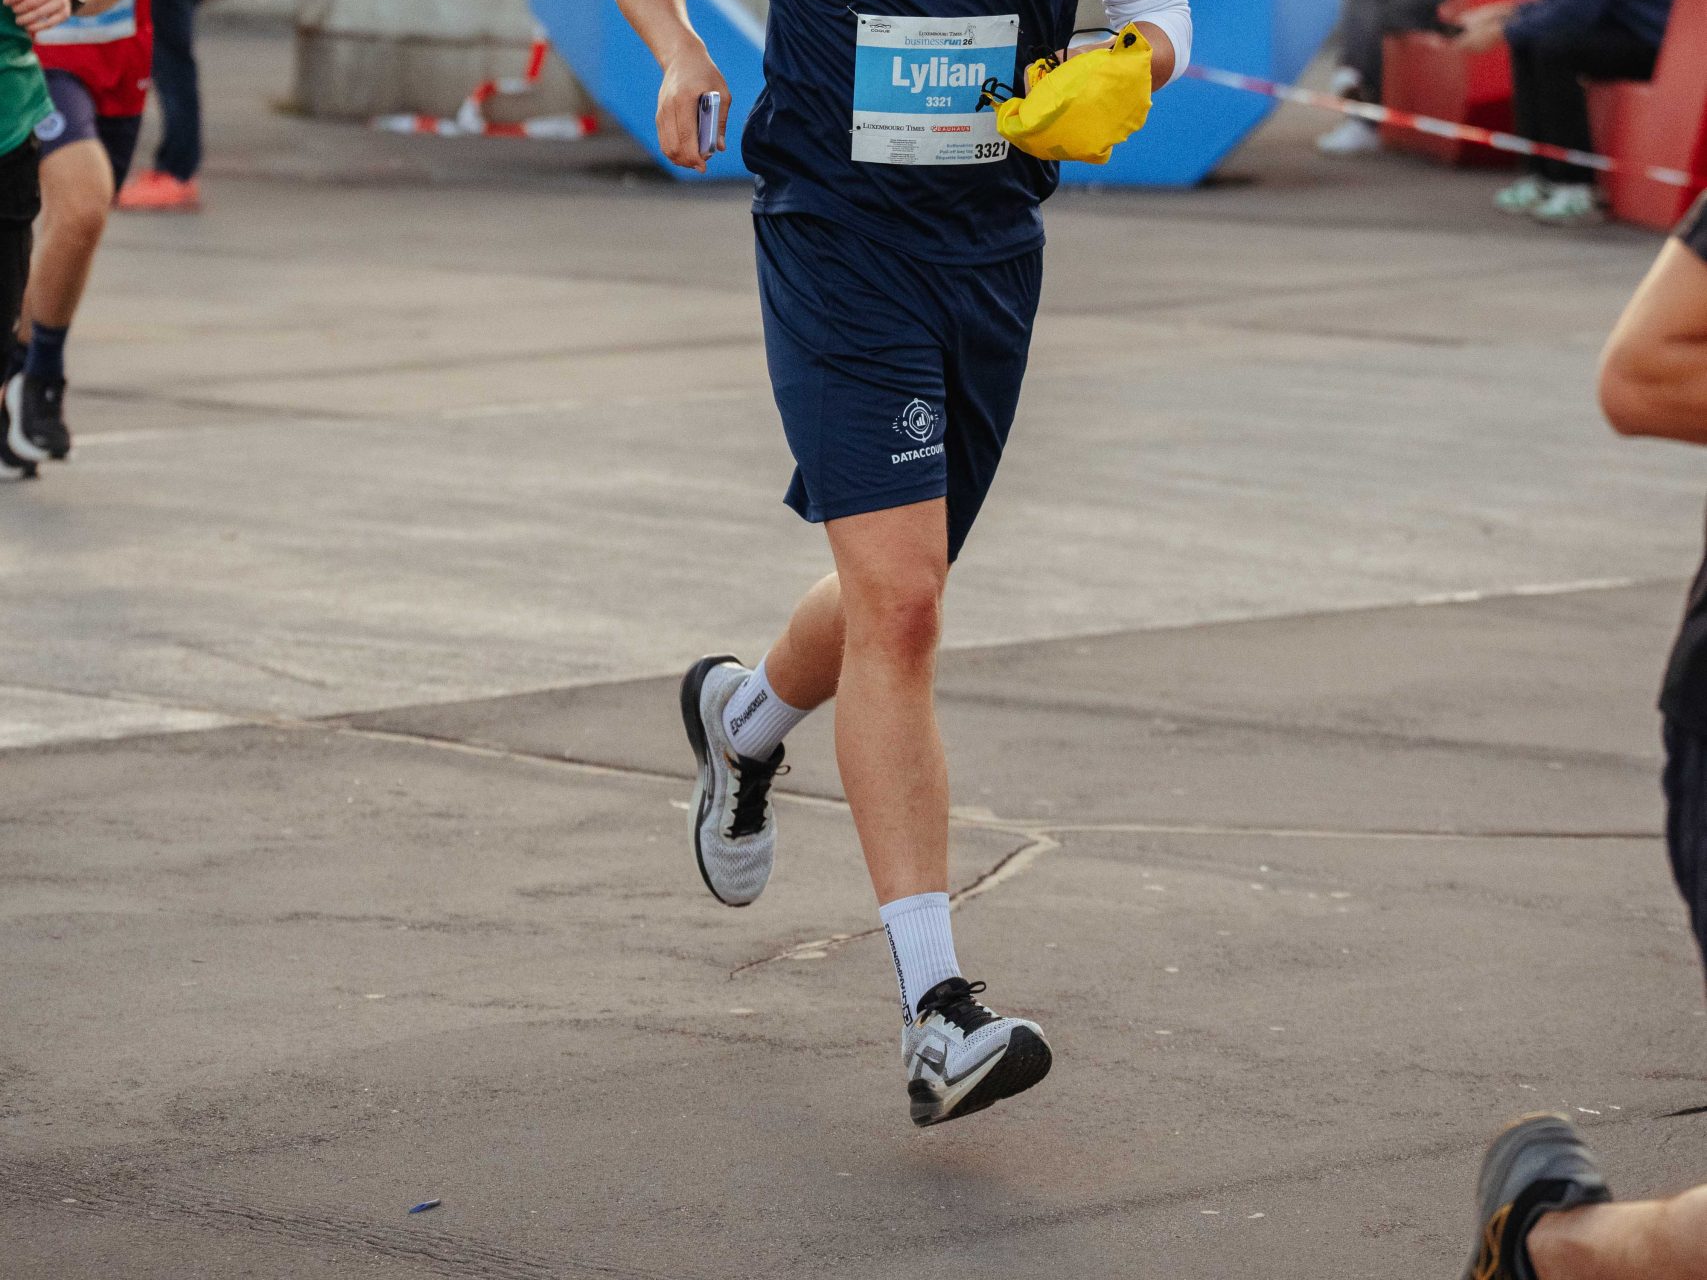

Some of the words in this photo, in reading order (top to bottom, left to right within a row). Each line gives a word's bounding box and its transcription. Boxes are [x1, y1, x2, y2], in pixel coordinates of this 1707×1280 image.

[892, 56, 986, 93] Lylian
[926, 96, 951, 107] 3321
[974, 141, 1006, 159] 3321
